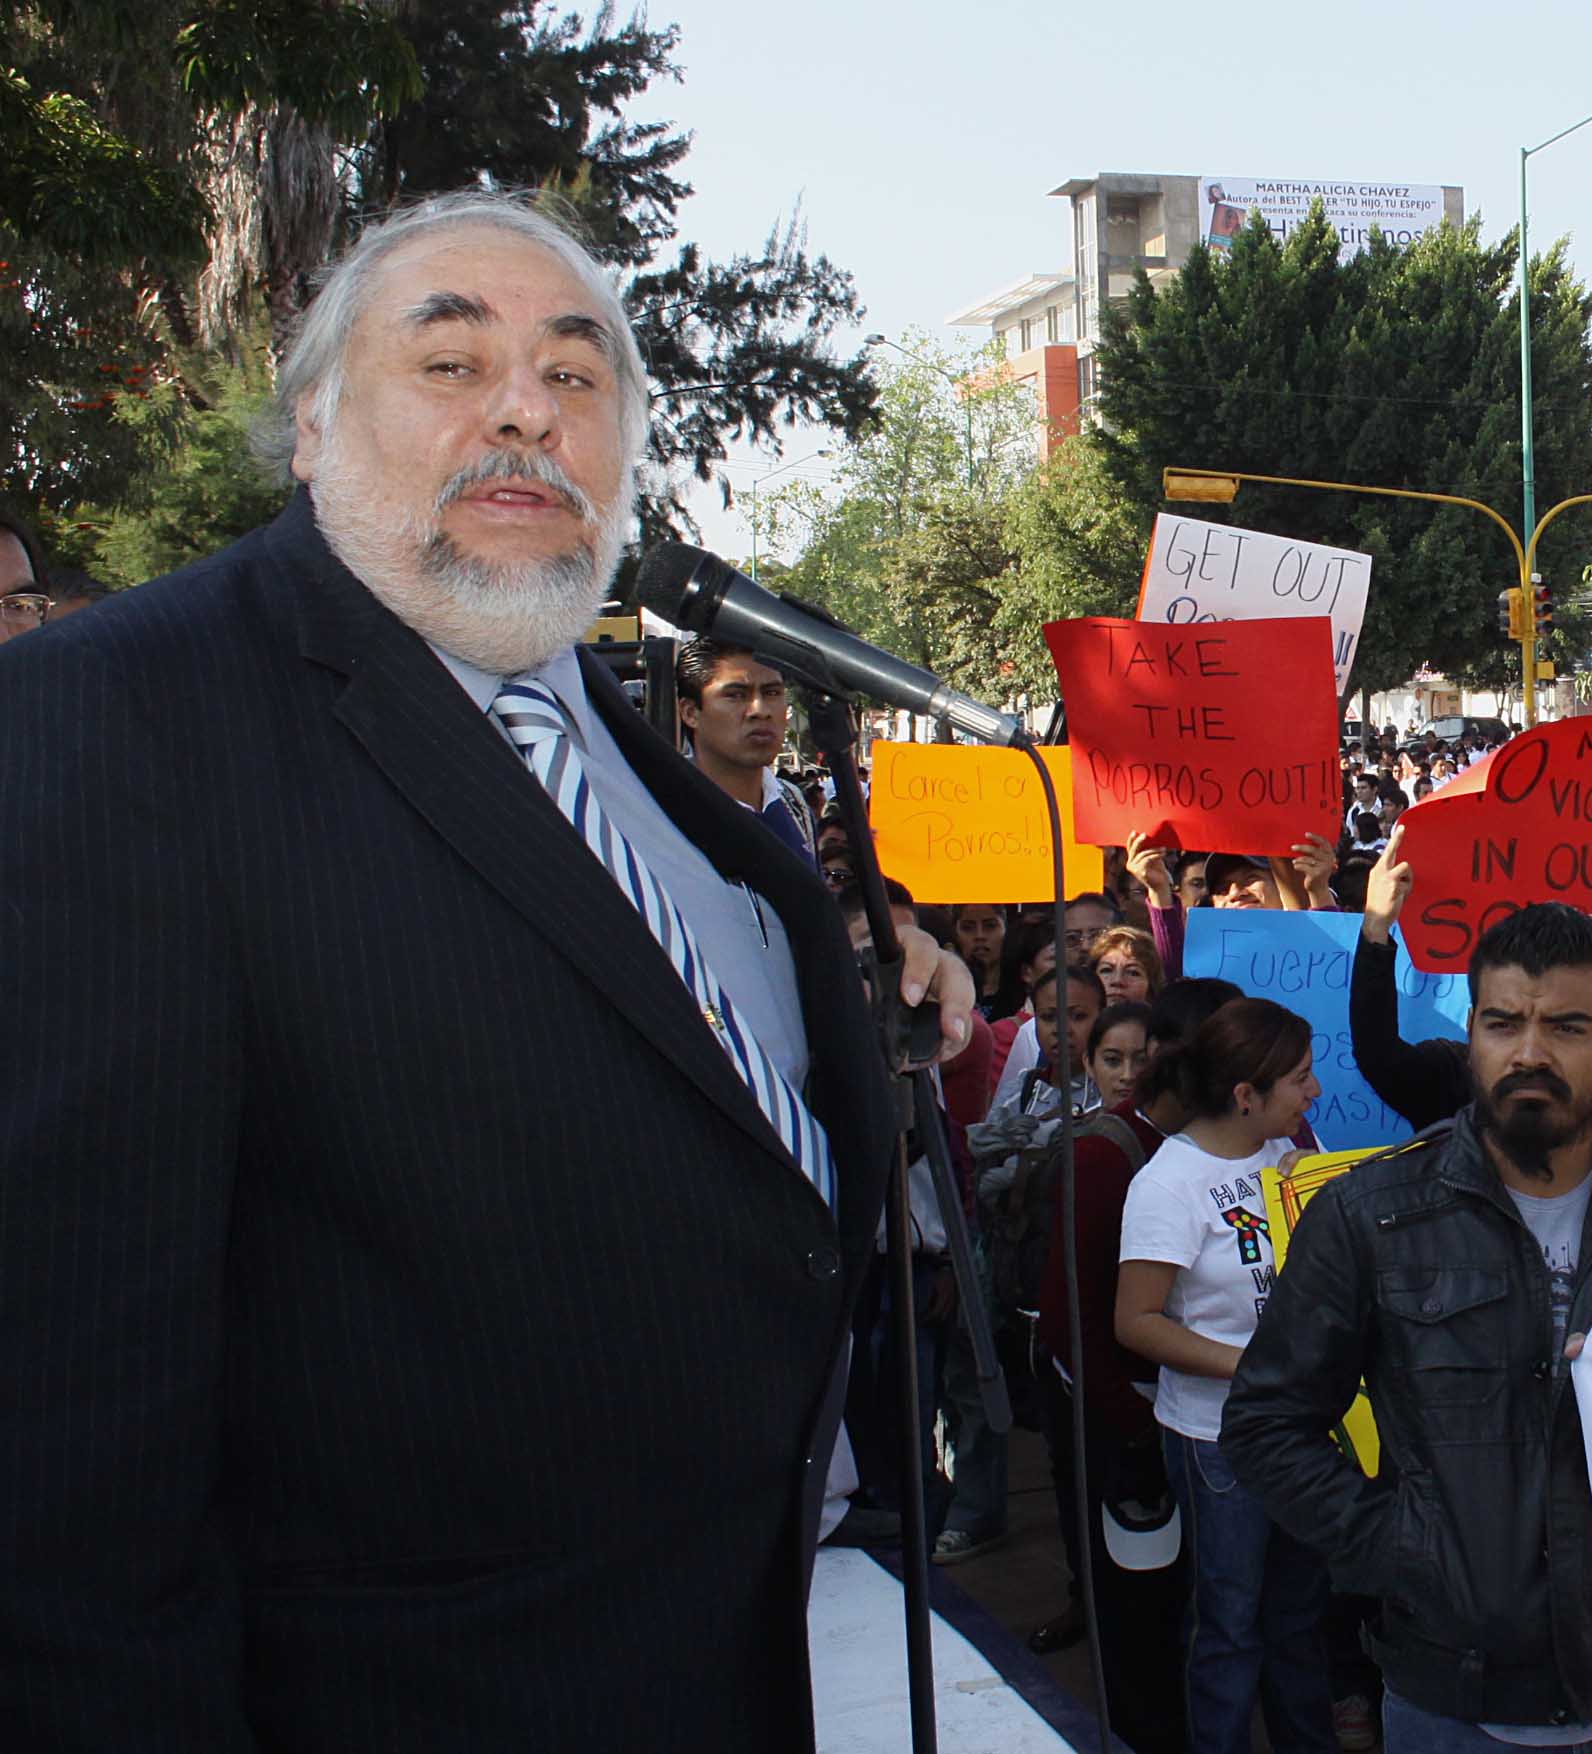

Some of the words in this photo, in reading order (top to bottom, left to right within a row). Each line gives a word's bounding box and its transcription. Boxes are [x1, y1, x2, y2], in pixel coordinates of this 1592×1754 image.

[1255, 182, 1311, 194] MARTHA
[1313, 184, 1356, 195] ALICIA
[1359, 186, 1410, 198] CHAVEZ
[1262, 195, 1276, 205] del
[1279, 195, 1301, 205] BEST
[1166, 521, 1250, 590] GET
[1272, 546, 1361, 614] OUT
[1089, 624, 1239, 677] TAKE
[1132, 703, 1236, 741] THE
[890, 751, 983, 805] Carcel
[1003, 775, 1027, 800] a
[1087, 746, 1225, 811] PORROS
[1239, 757, 1339, 816] OUT!!
[1471, 837, 1518, 884] IN
[1215, 928, 1351, 993] Fuera
